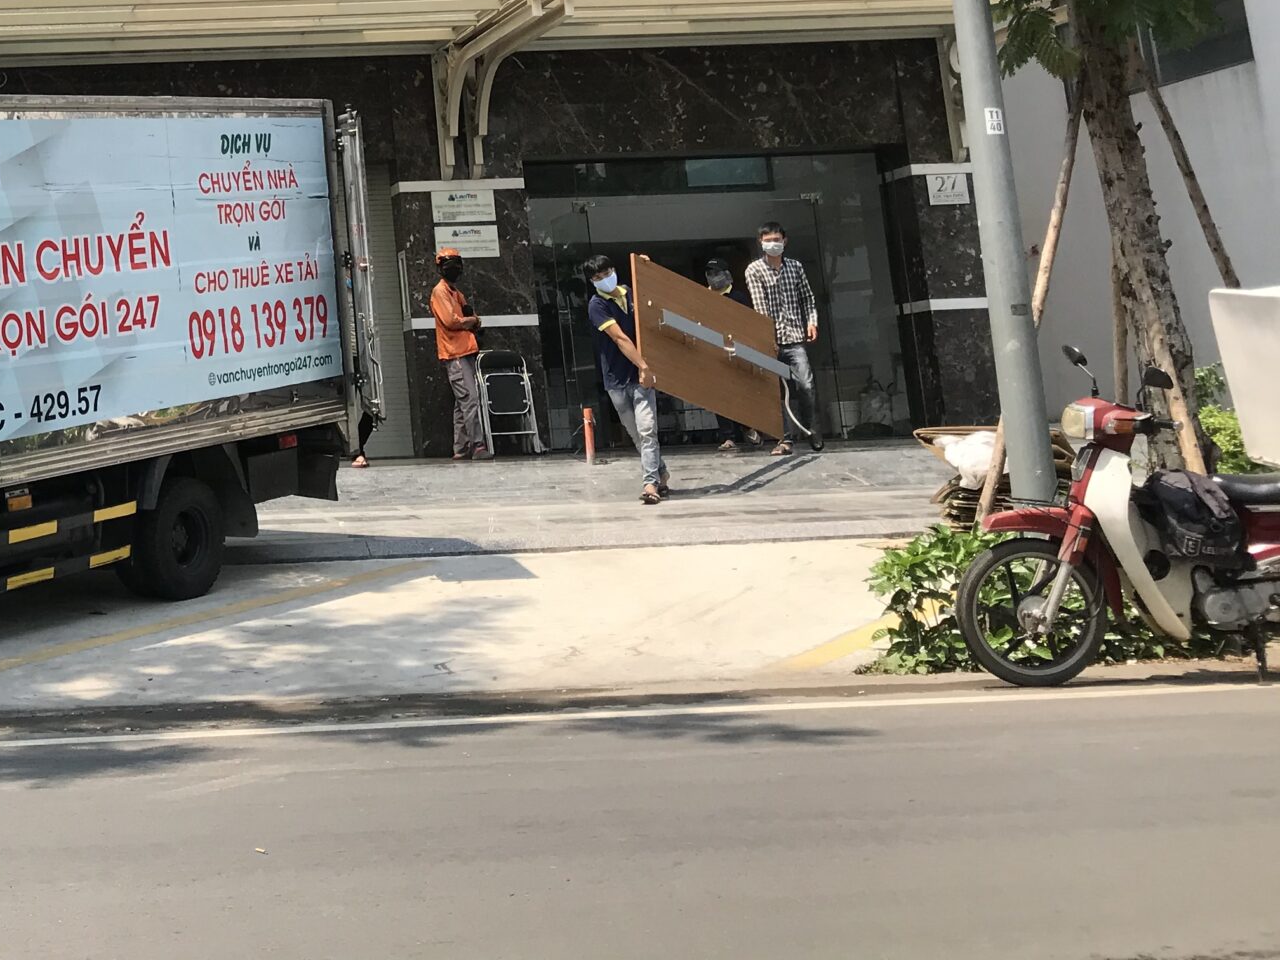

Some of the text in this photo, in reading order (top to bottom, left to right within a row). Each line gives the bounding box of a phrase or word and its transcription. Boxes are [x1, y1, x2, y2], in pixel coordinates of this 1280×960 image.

[988, 110, 999, 120] T1
[990, 122, 1002, 132] 40
[220, 133, 271, 159] DỊCH VỤ
[198, 160, 299, 194] CHUYỂN NHÀ
[936, 176, 957, 192] 27
[217, 194, 286, 227] TRỌN GÓI
[35, 211, 171, 281] CHUYỂN
[248, 231, 261, 251] VÀ
[194, 252, 319, 294] CHO THUÊ XE TẢI
[55, 293, 108, 341] GÓI
[116, 295, 160, 333] 247
[188, 294, 328, 360] 0918 139 379
[216, 354, 333, 385] vanchuyentrongoi247.com
[30, 384, 102, 423] 429.57
